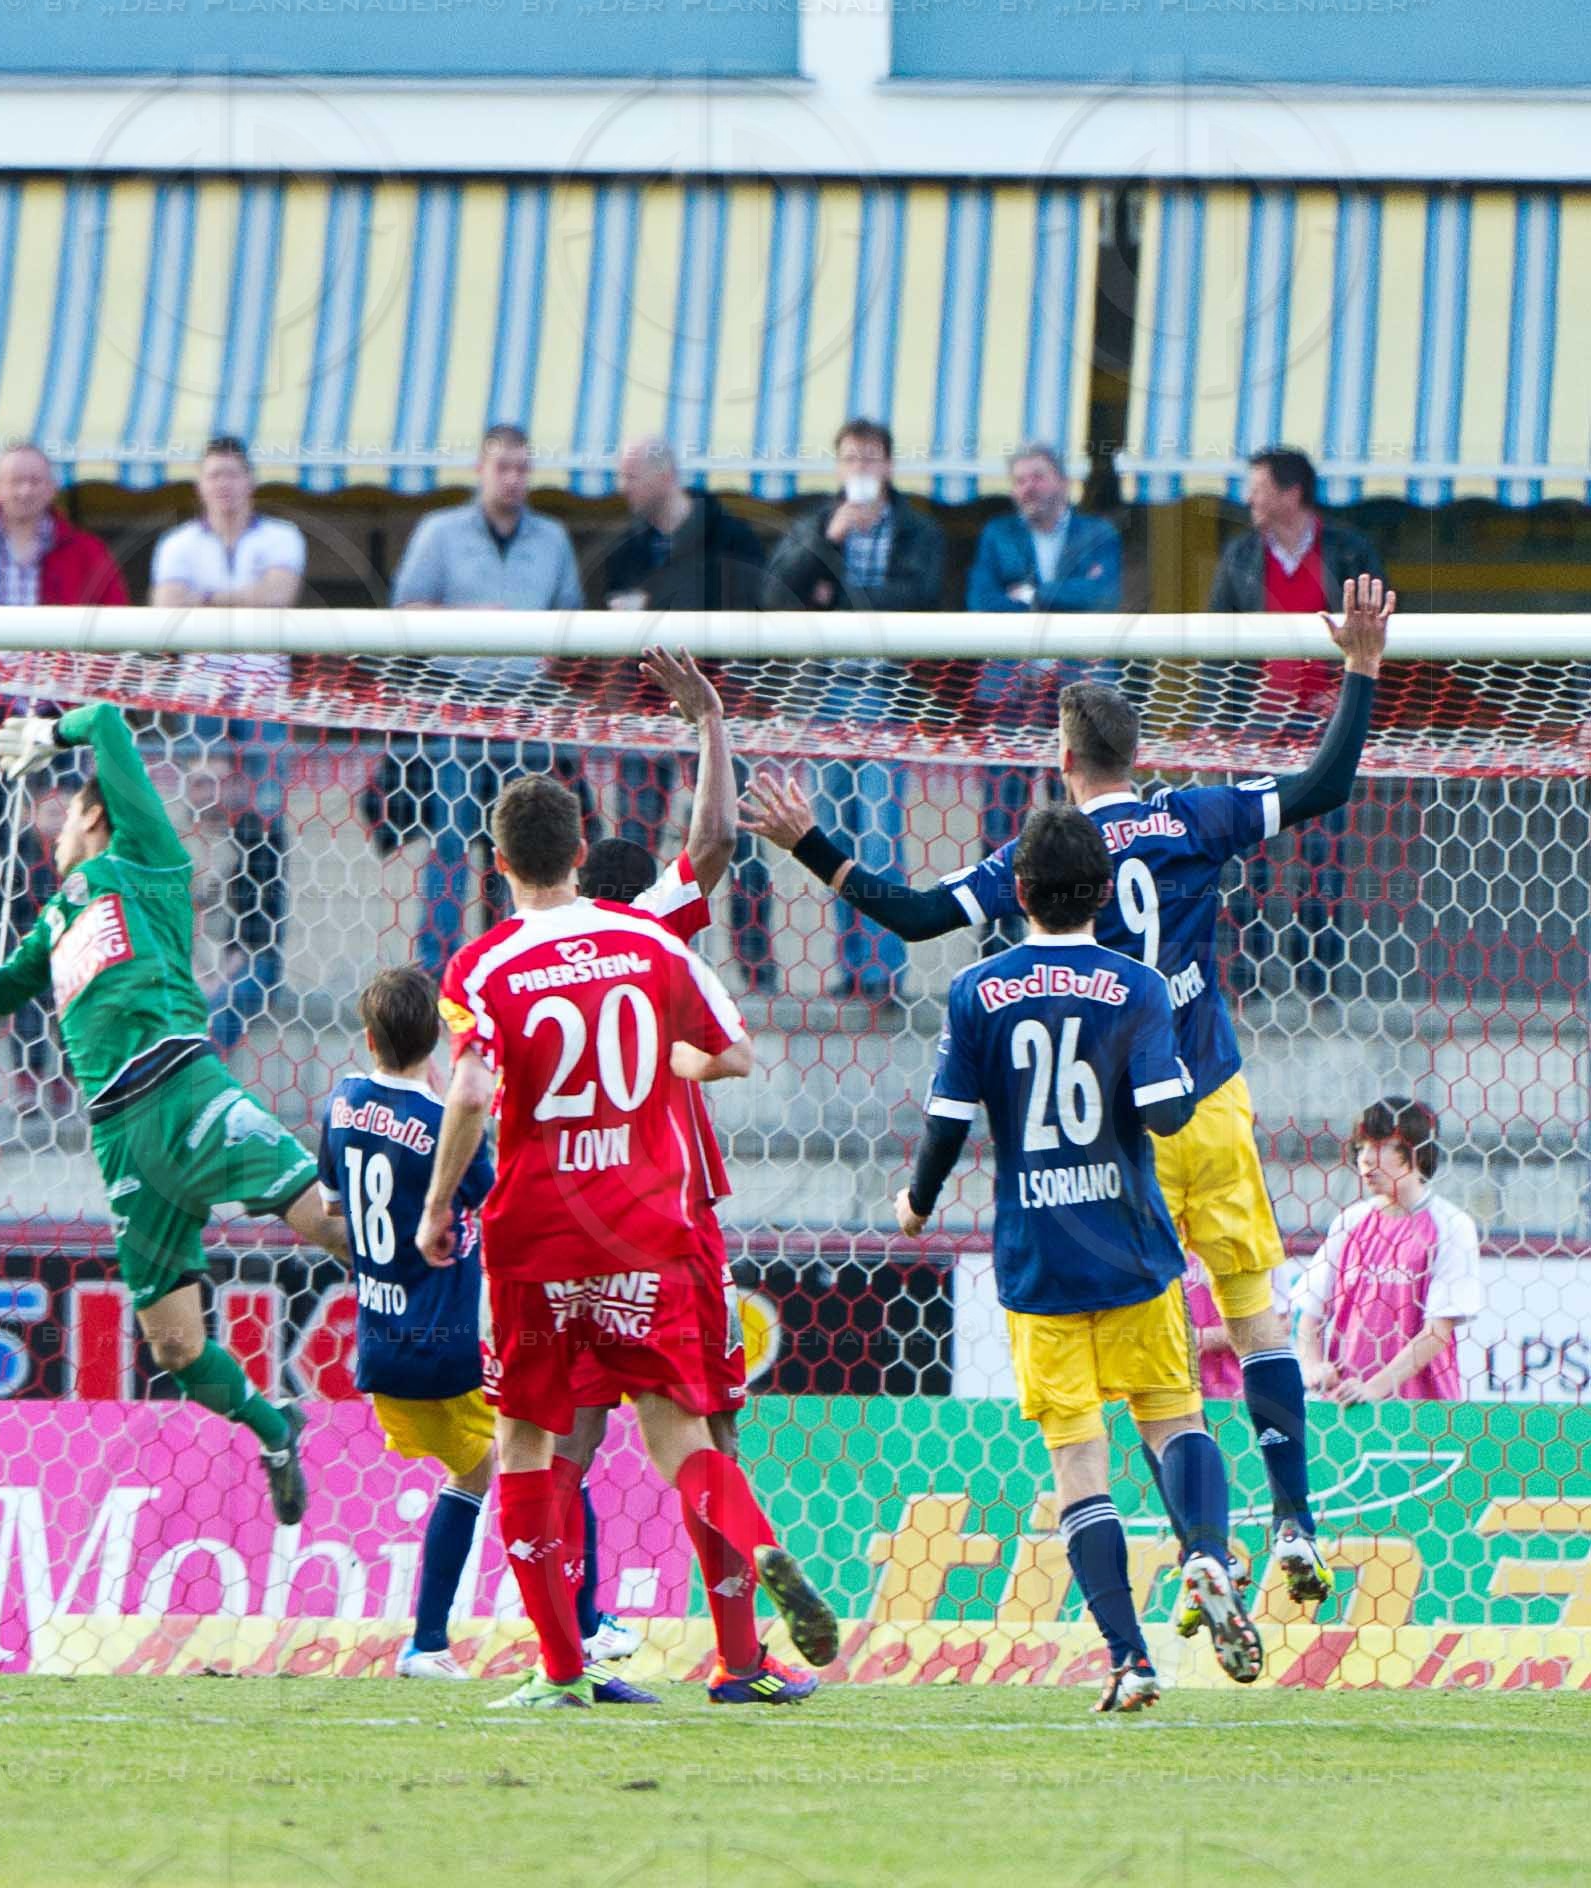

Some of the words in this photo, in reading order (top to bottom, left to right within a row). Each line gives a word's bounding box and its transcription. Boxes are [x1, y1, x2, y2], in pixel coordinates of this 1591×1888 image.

[1117, 857, 1160, 968] 9
[977, 964, 1046, 1013] Red
[1048, 965, 1130, 1006] Bulls
[522, 983, 659, 1122] 20
[1011, 1016, 1103, 1152] 26
[331, 1096, 374, 1132] Red
[370, 1104, 437, 1156] Bulls
[345, 1146, 397, 1266] 18
